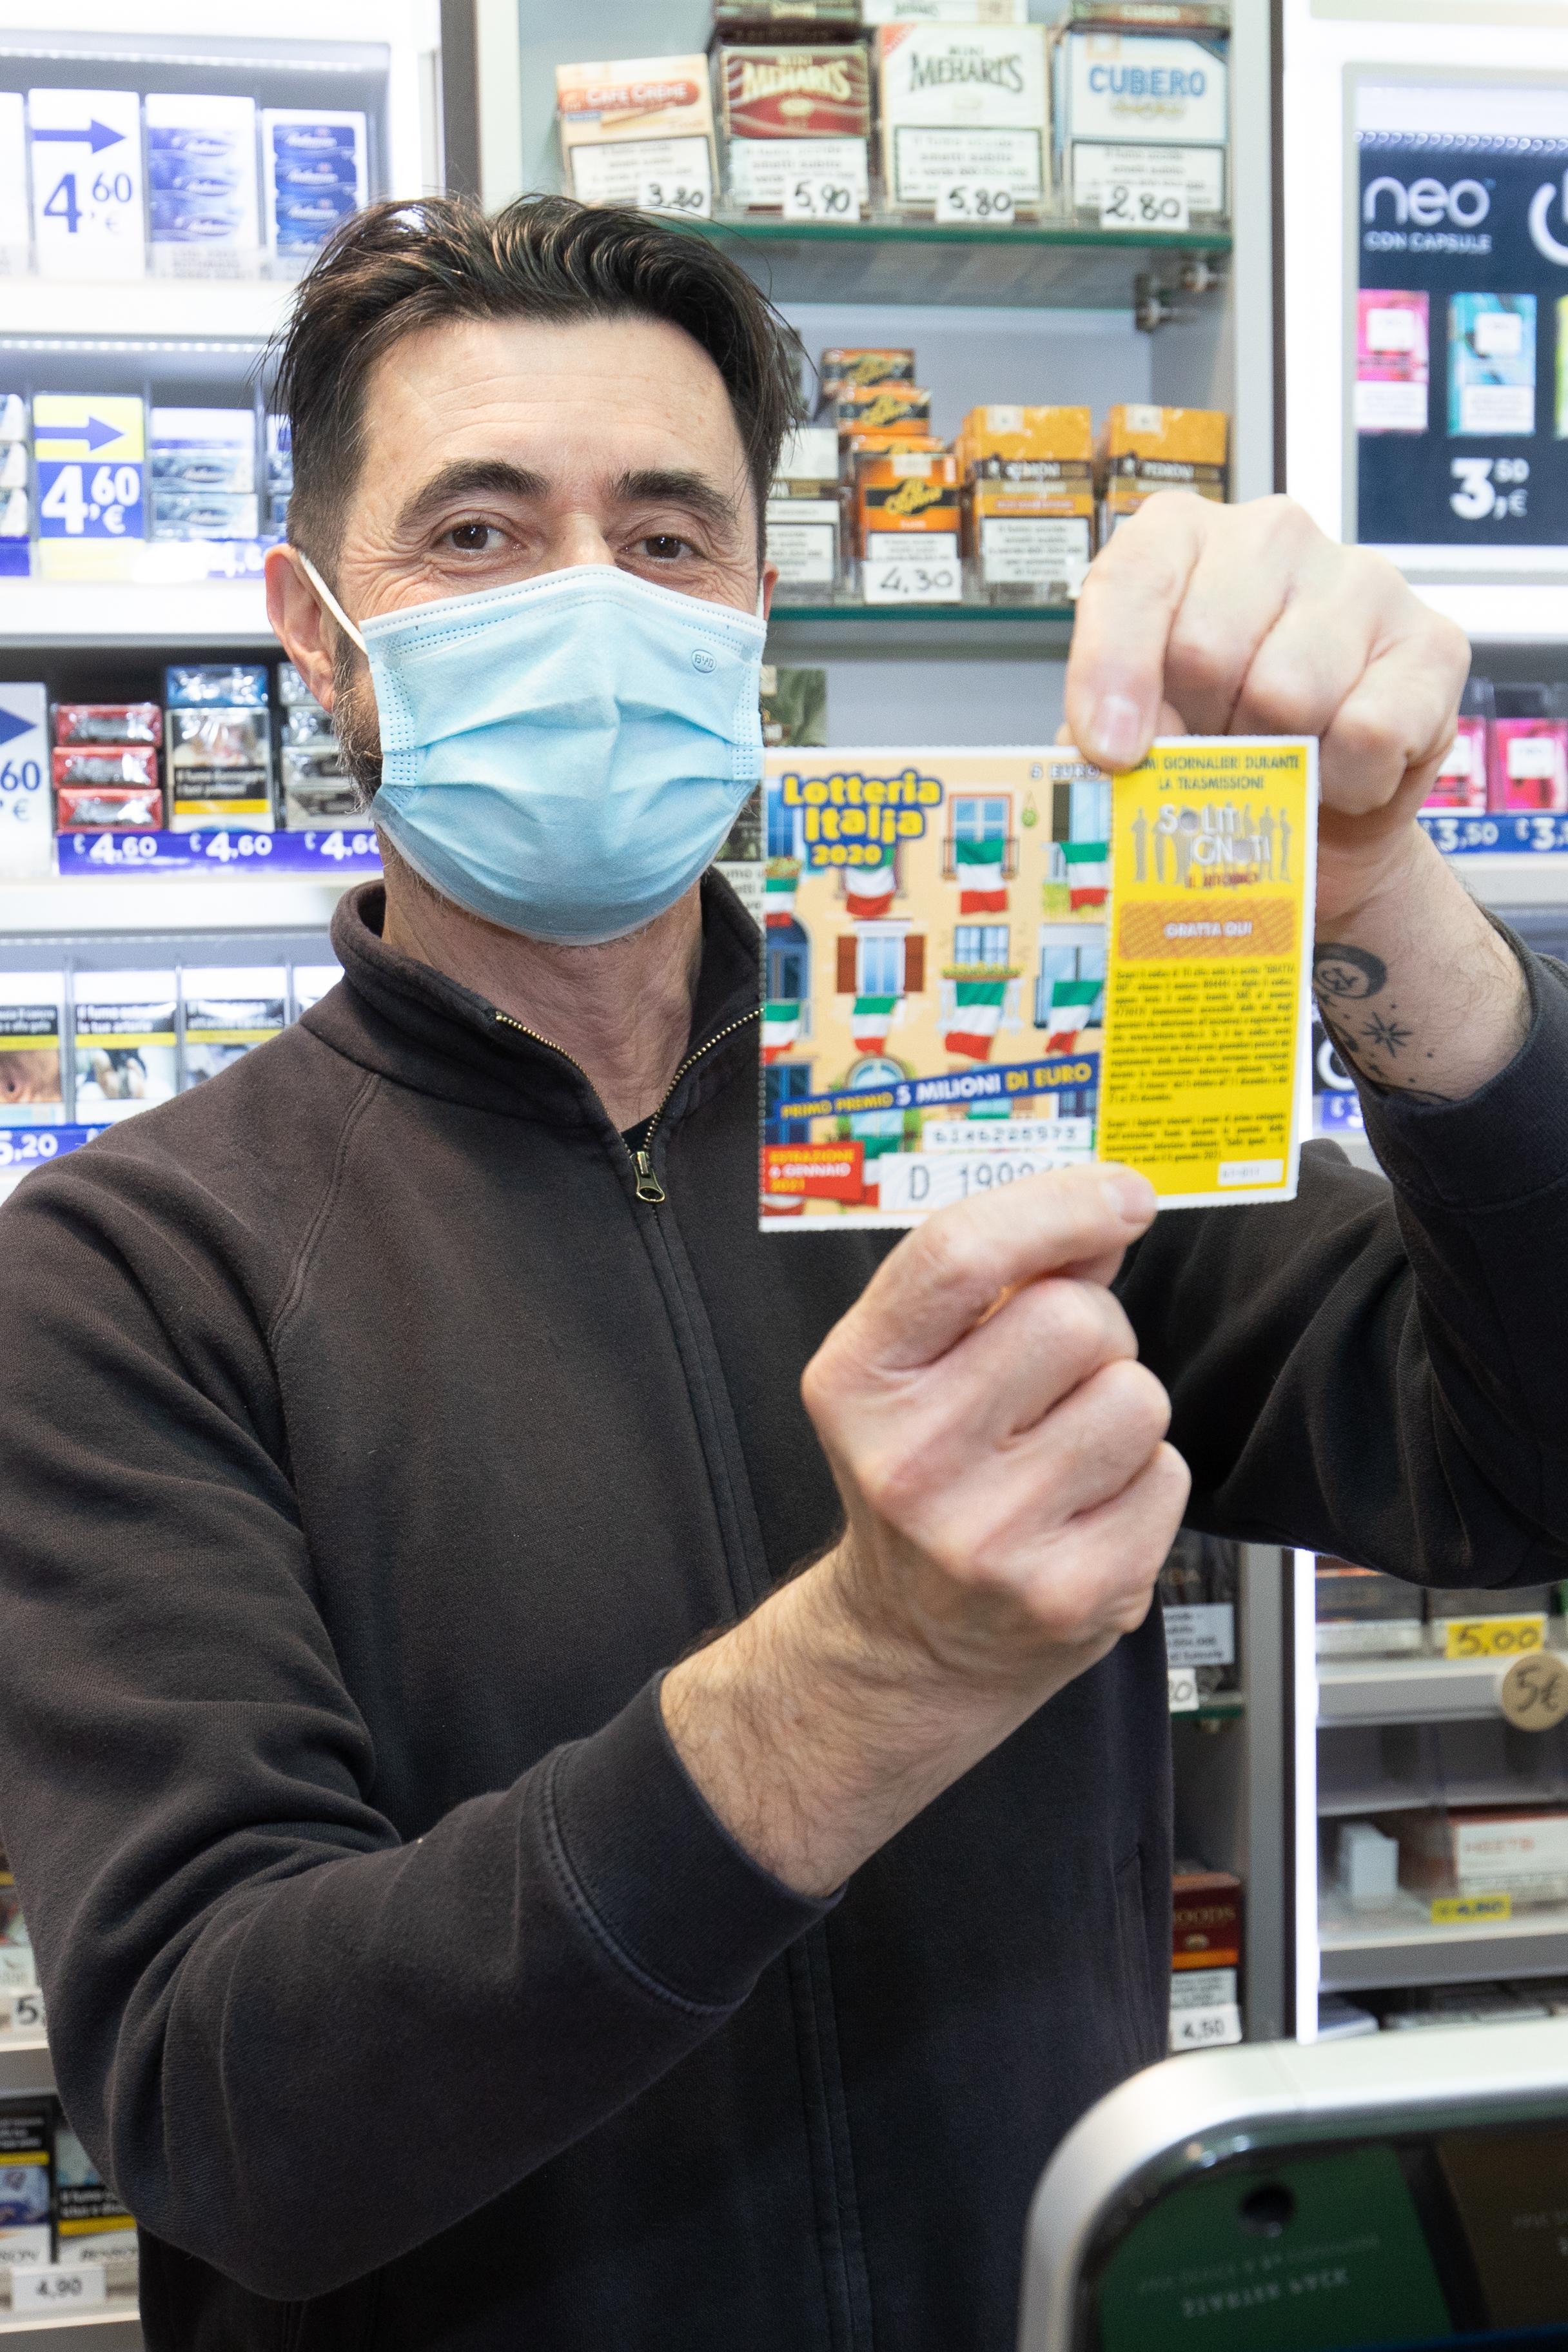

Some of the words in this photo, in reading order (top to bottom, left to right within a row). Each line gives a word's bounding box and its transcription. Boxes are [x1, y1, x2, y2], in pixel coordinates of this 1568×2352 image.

[1088, 64, 1207, 98] CUBERO
[1363, 175, 1491, 228] neo
[783, 770, 943, 807] Lotteria
[804, 805, 925, 843] Italia
[90, 833, 157, 865] 4,60
[206, 832, 273, 863] 4,60
[811, 843, 882, 865] 2020
[1163, 922, 1222, 939] GRATTA
[1225, 920, 1253, 937] QUI
[781, 1099, 832, 1119] PRIMO
[834, 1091, 894, 1113] PREMIO
[896, 1084, 911, 1106] 5
[916, 1073, 1001, 1102] MILIONI
[1006, 1070, 1029, 1092] DI
[1034, 1063, 1092, 1087] EURO
[909, 1164, 930, 1202] D
